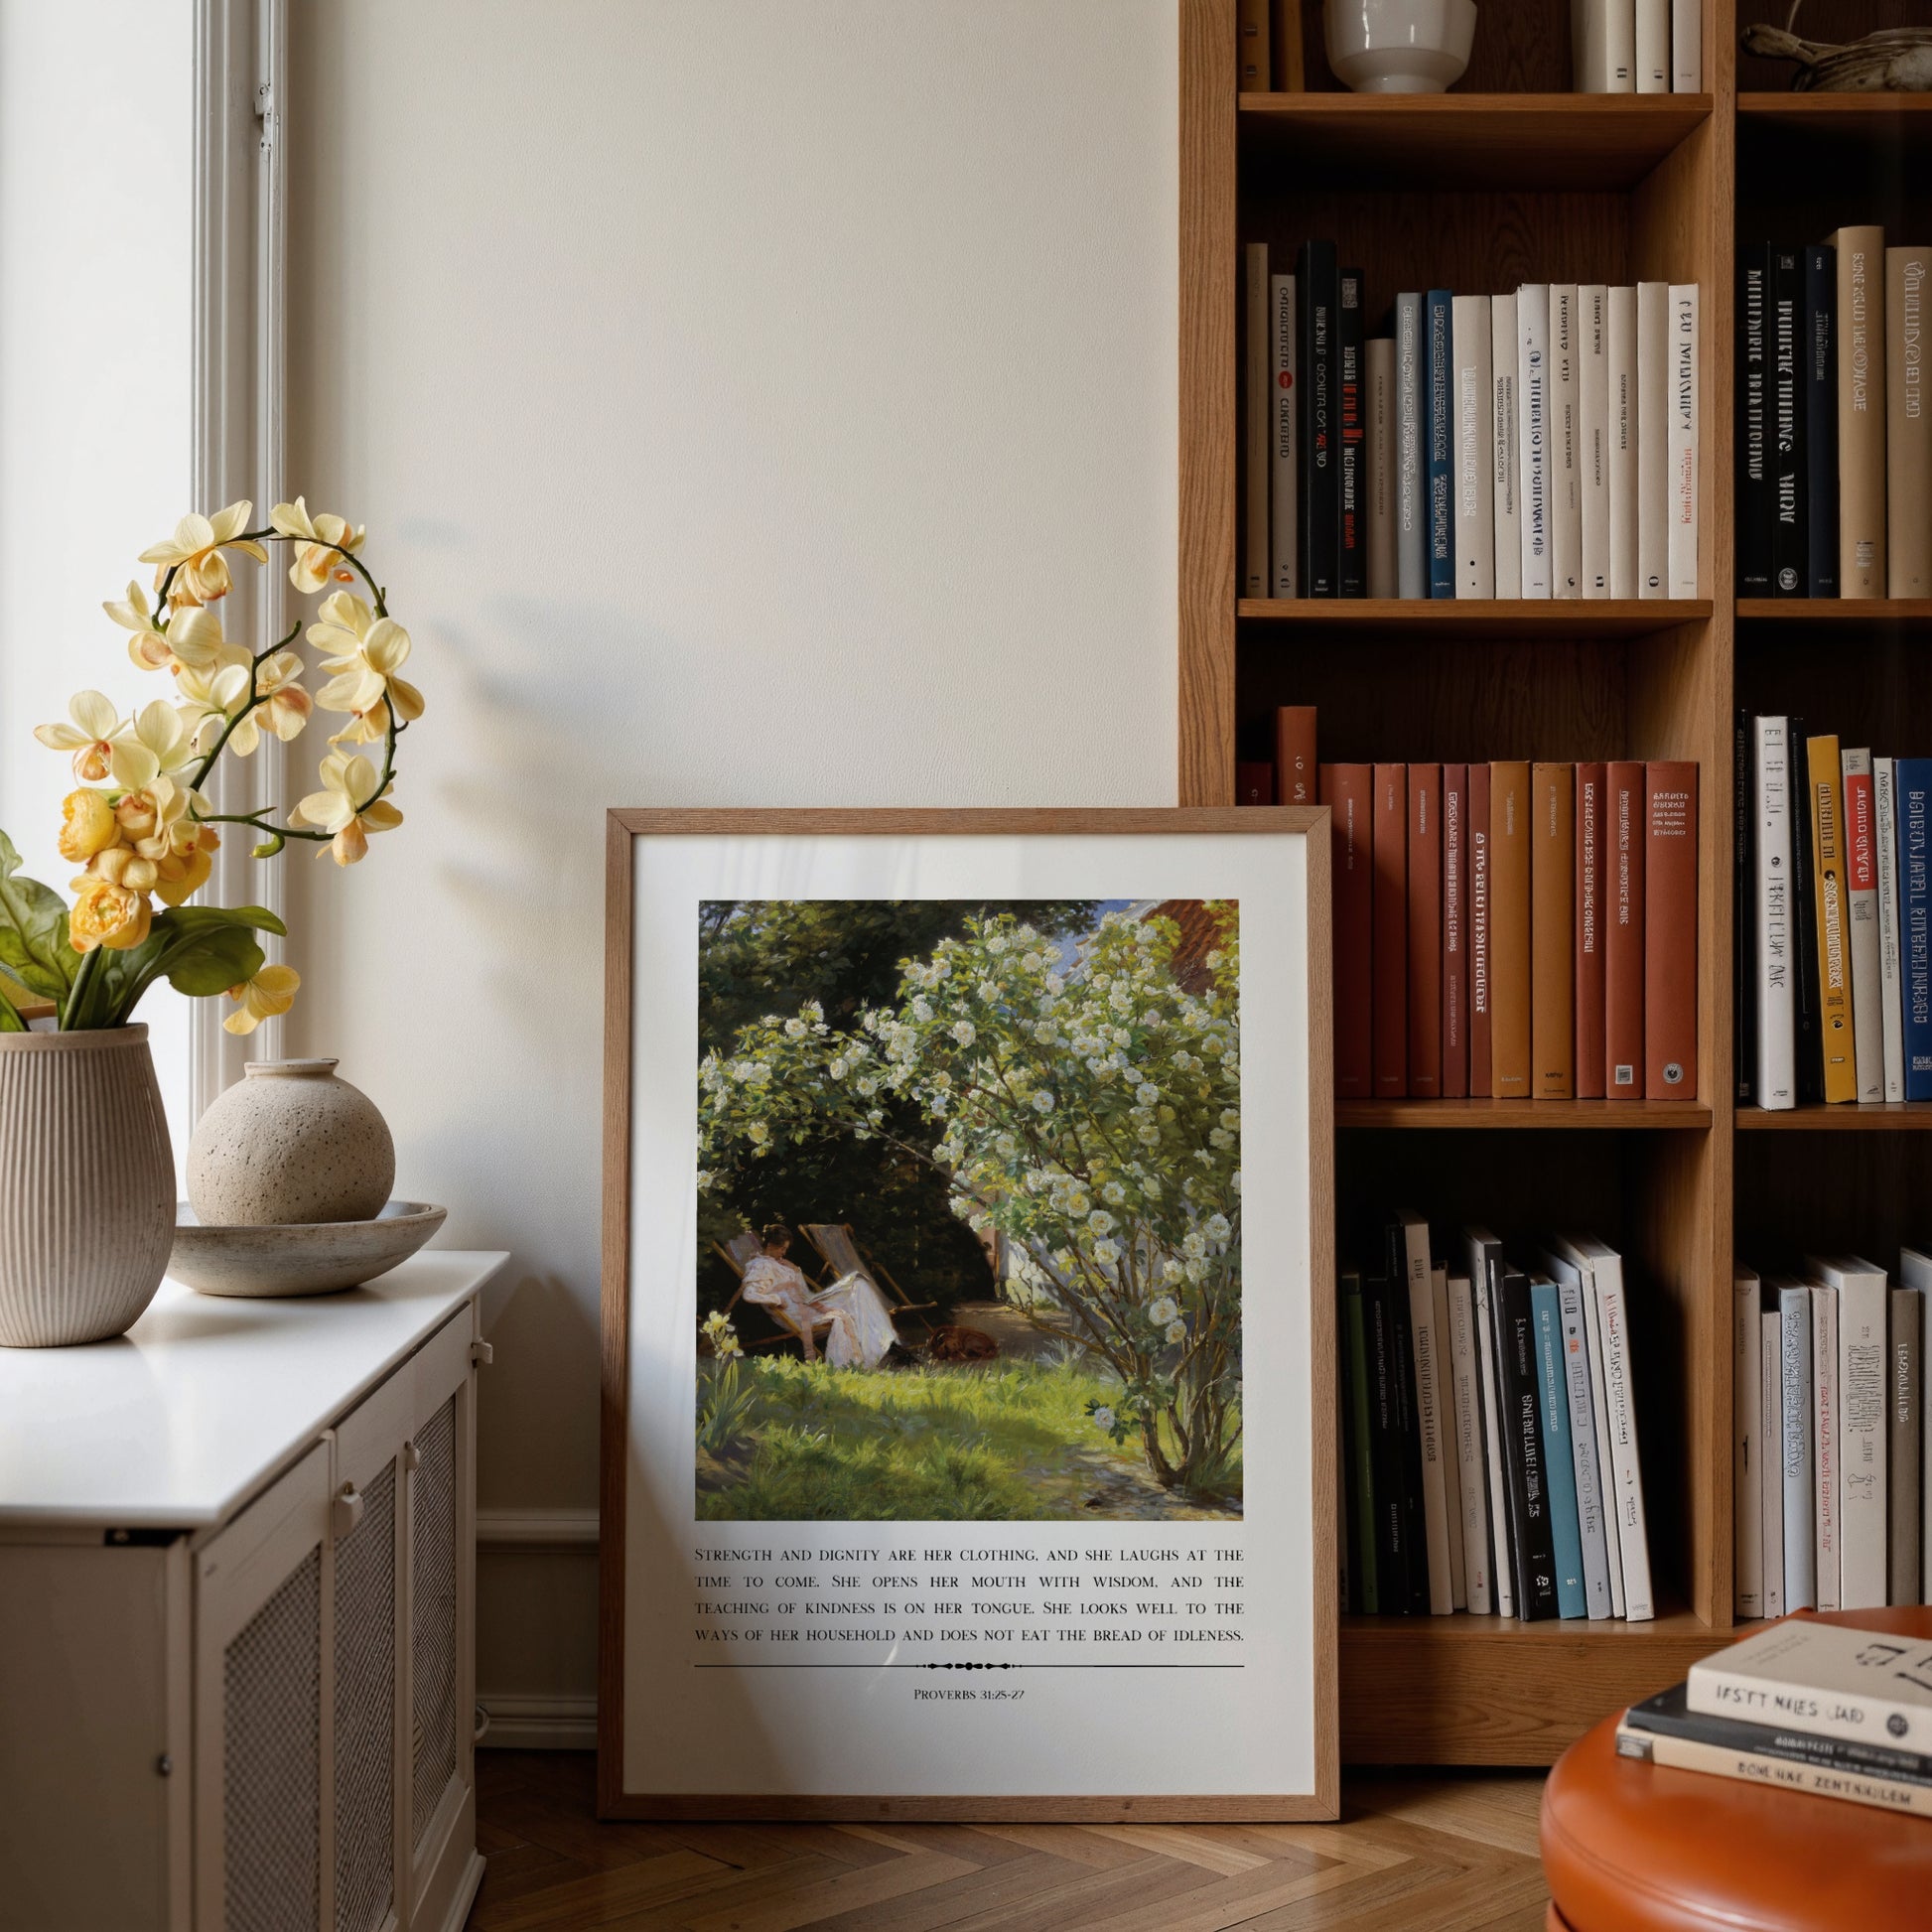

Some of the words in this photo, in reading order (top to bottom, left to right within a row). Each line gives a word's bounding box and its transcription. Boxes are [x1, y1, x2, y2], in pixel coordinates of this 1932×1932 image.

[694, 1548, 772, 1562] STRENGTH
[779, 1549, 812, 1562] AND
[818, 1549, 881, 1562] DIGNITY
[888, 1549, 917, 1562] ARE
[923, 1549, 953, 1562] HER
[1045, 1549, 1078, 1562] AND
[1084, 1549, 1113, 1562] SHE
[1120, 1549, 1179, 1562] LAUGHS
[1185, 1549, 1208, 1562] AT
[1213, 1549, 1245, 1562] THE
[694, 1576, 732, 1587] TIME
[743, 1576, 764, 1588] TO
[774, 1576, 820, 1588] COME.
[831, 1574, 862, 1588] SHE
[872, 1576, 918, 1588] OPENS
[929, 1576, 959, 1588] HER
[971, 1576, 1027, 1588] MOUTH
[1038, 1576, 1080, 1588] WITH
[1170, 1576, 1203, 1588] AND
[1213, 1576, 1245, 1588] THE
[694, 1602, 769, 1614] TEACHING
[777, 1602, 797, 1614] OF
[805, 1602, 876, 1614] KINDNESS
[884, 1602, 897, 1614] IS
[903, 1602, 925, 1614] ON
[933, 1602, 963, 1614] HER
[970, 1602, 1035, 1615] TONGUE.
[1042, 1600, 1072, 1615] SHE
[1079, 1602, 1128, 1615] LOOKS
[1135, 1602, 1178, 1615] WELL
[1184, 1602, 1207, 1615] TO
[1213, 1602, 1245, 1615] THE
[694, 1629, 739, 1641] WAYS
[744, 1629, 764, 1641] OF
[769, 1629, 799, 1641] HER
[806, 1629, 897, 1642] HOUSEHOLD
[901, 1629, 934, 1642] AND
[940, 1629, 978, 1641] DOES
[984, 1629, 1016, 1642] NOT
[1021, 1629, 1051, 1642] EAT
[1055, 1629, 1087, 1642] THE
[1093, 1629, 1143, 1642] BREAD
[1148, 1629, 1168, 1642] OF
[1173, 1629, 1244, 1642] IDLENESS.
[913, 1689, 977, 1701] PROVERBS
[979, 1690, 1026, 1701] 31:25-27
